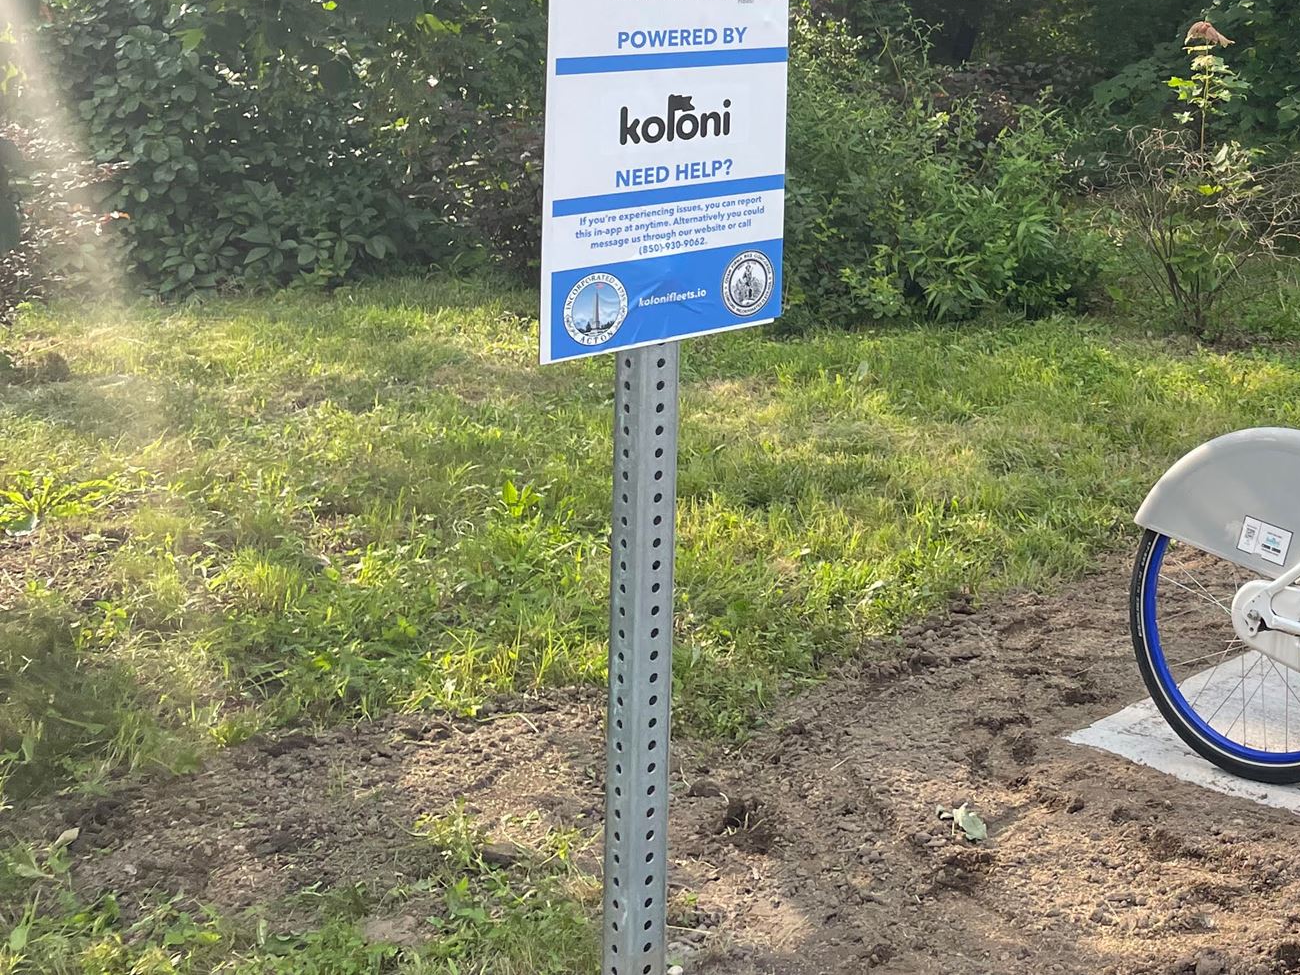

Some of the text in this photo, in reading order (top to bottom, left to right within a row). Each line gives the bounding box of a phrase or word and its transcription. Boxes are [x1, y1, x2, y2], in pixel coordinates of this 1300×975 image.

[617, 27, 748, 49] POWERED BY
[619, 94, 731, 145] koloni
[615, 158, 733, 187] NEED HELP?
[575, 230, 592, 239] this
[594, 227, 622, 236] in-app
[634, 220, 671, 231] anytime.
[673, 211, 725, 225] Alternatively
[727, 211, 741, 220] you
[743, 206, 765, 215] could
[580, 217, 587, 225] If
[588, 215, 616, 227] you're
[619, 207, 674, 221] experiencing
[677, 204, 703, 213] issues,
[705, 203, 720, 211] you
[738, 196, 762, 206] report
[590, 237, 629, 249] message
[643, 230, 676, 241] through
[694, 223, 726, 234] website
[738, 219, 752, 228] call
[566, 275, 615, 310] INCORPORATED
[638, 288, 707, 307] kolonifleets.io
[580, 331, 613, 344] ACTON
